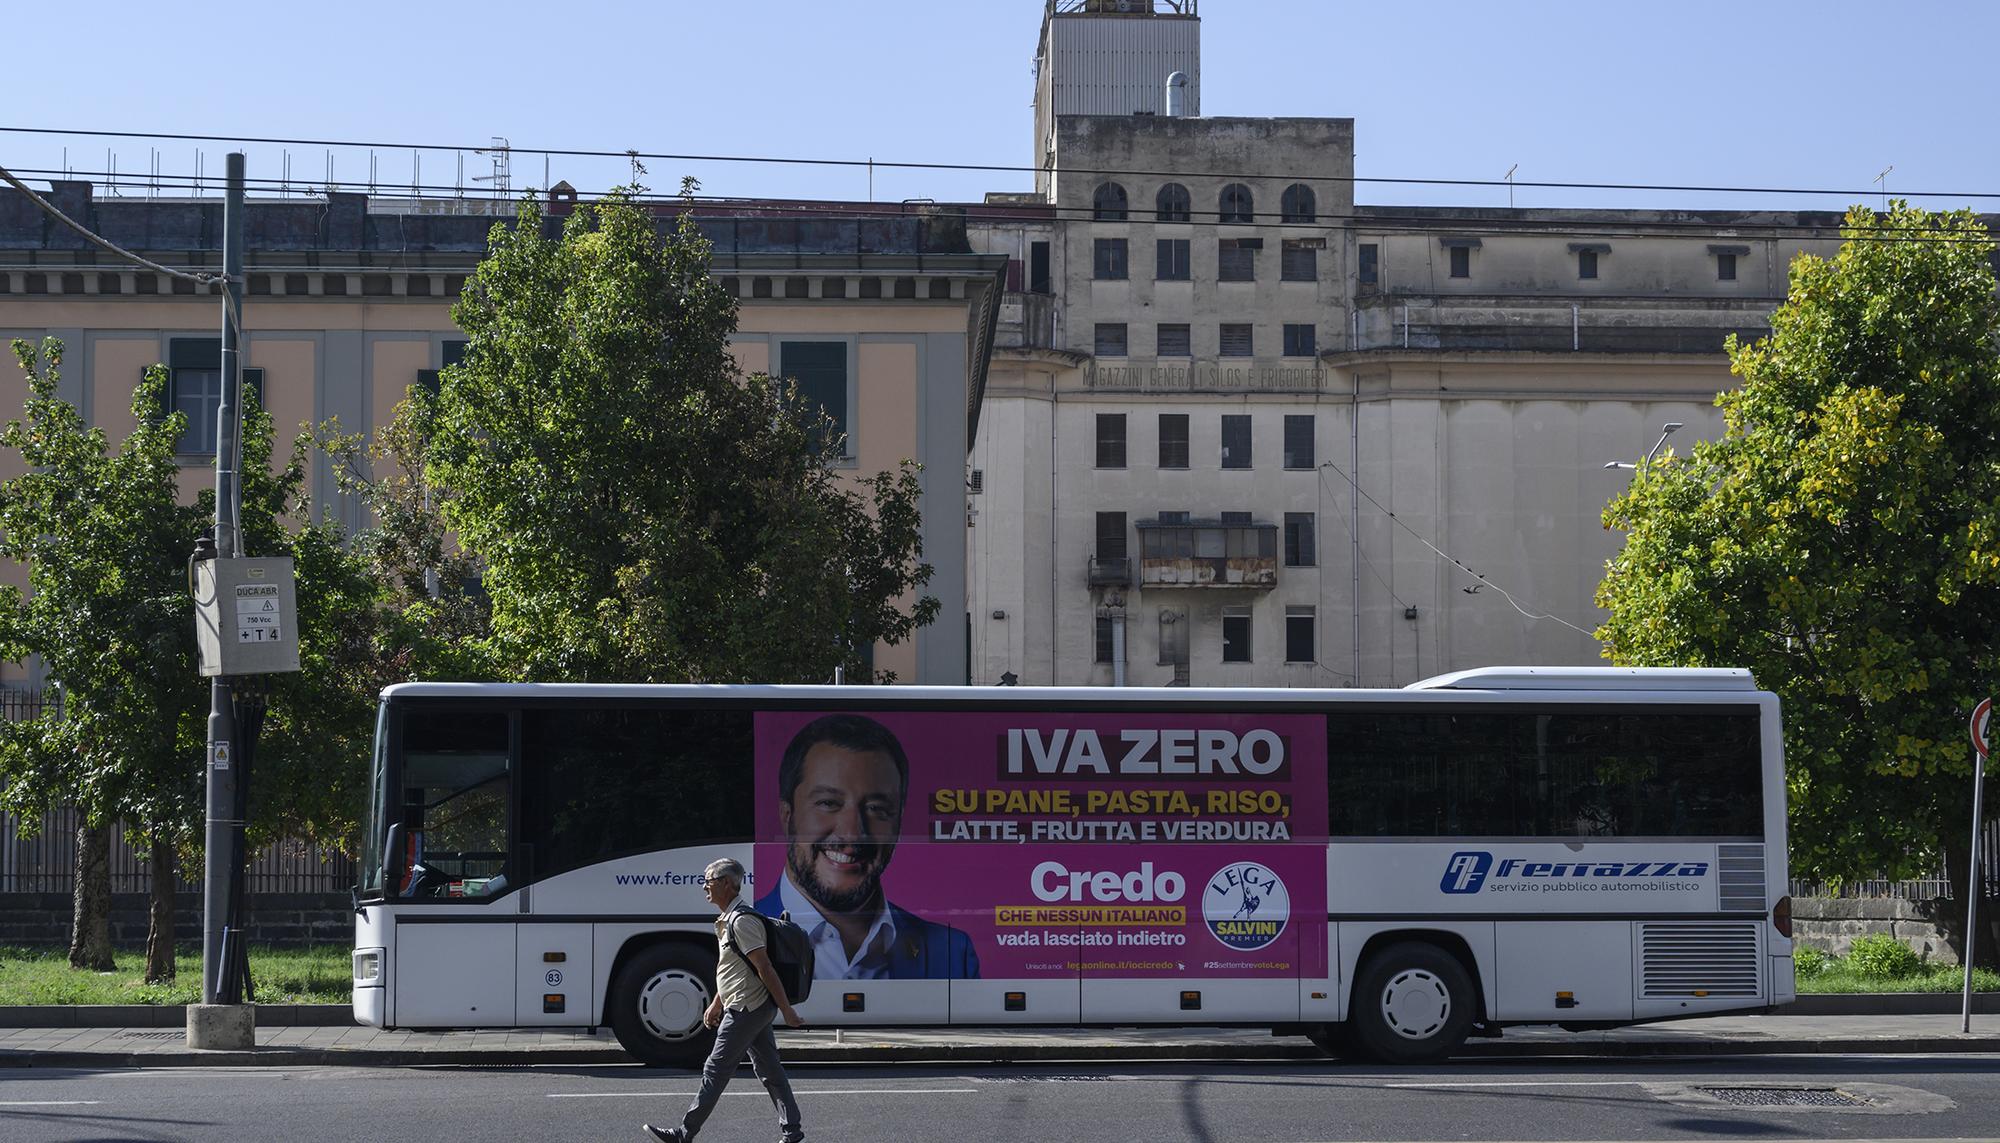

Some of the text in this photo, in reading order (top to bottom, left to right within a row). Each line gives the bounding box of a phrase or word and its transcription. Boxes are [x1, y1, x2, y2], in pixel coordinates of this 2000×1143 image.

[1082, 367, 1328, 387] MAGAZZINI GENERALI SILOS E FRIGORIFERI
[236, 587, 278, 596] DUCA ABR
[255, 629, 264, 641] T
[270, 629, 278, 640] 4
[1007, 728, 1285, 775] IVA ZERO
[935, 789, 1290, 819] SU PANE, PASTA, RISO,
[934, 820, 1291, 845] LATTE, FRUTTA E VERDURA
[1495, 859, 1709, 878] Ferrazza
[1030, 860, 1186, 902] Credo
[1211, 866, 1277, 896] LEGA
[1490, 880, 1700, 893] servizio pubblico automobilistico
[999, 909, 1182, 922] CHE NESSUN ITALIANO
[1216, 922, 1277, 935] SALVINI
[996, 930, 1186, 946] vada lasciato indietro
[1067, 961, 1174, 971] legaonline.it/iocicredo
[1203, 961, 1290, 970] #25settembrevotoLega
[548, 973, 560, 982] 83
